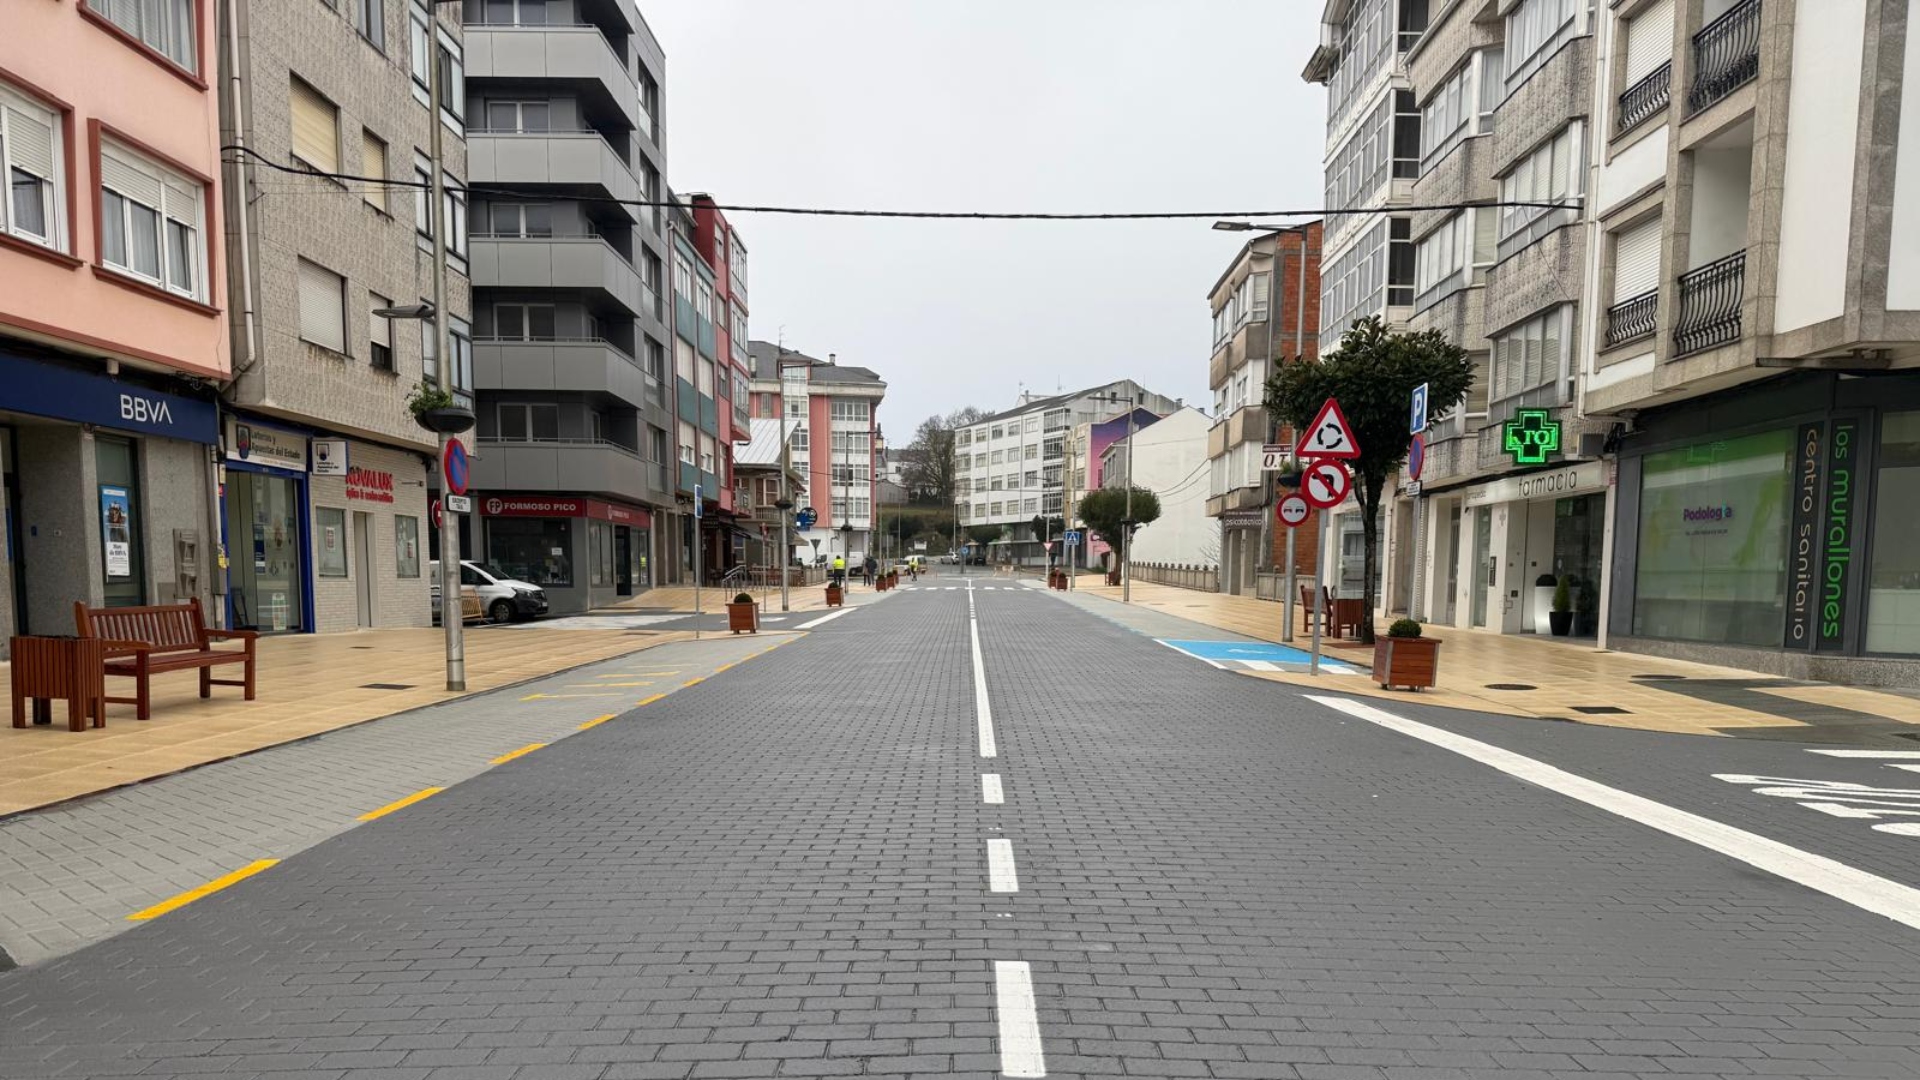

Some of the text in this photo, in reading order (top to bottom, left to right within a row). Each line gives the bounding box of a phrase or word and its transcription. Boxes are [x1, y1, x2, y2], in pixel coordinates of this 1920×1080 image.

[120, 394, 173, 424] BBVA
[1518, 469, 1578, 497] farmacia
[504, 502, 551, 511] FORMOSO
[553, 503, 576, 511] PICO
[1793, 428, 1818, 640] centro sanitario
[1823, 425, 1854, 638] los murallones
